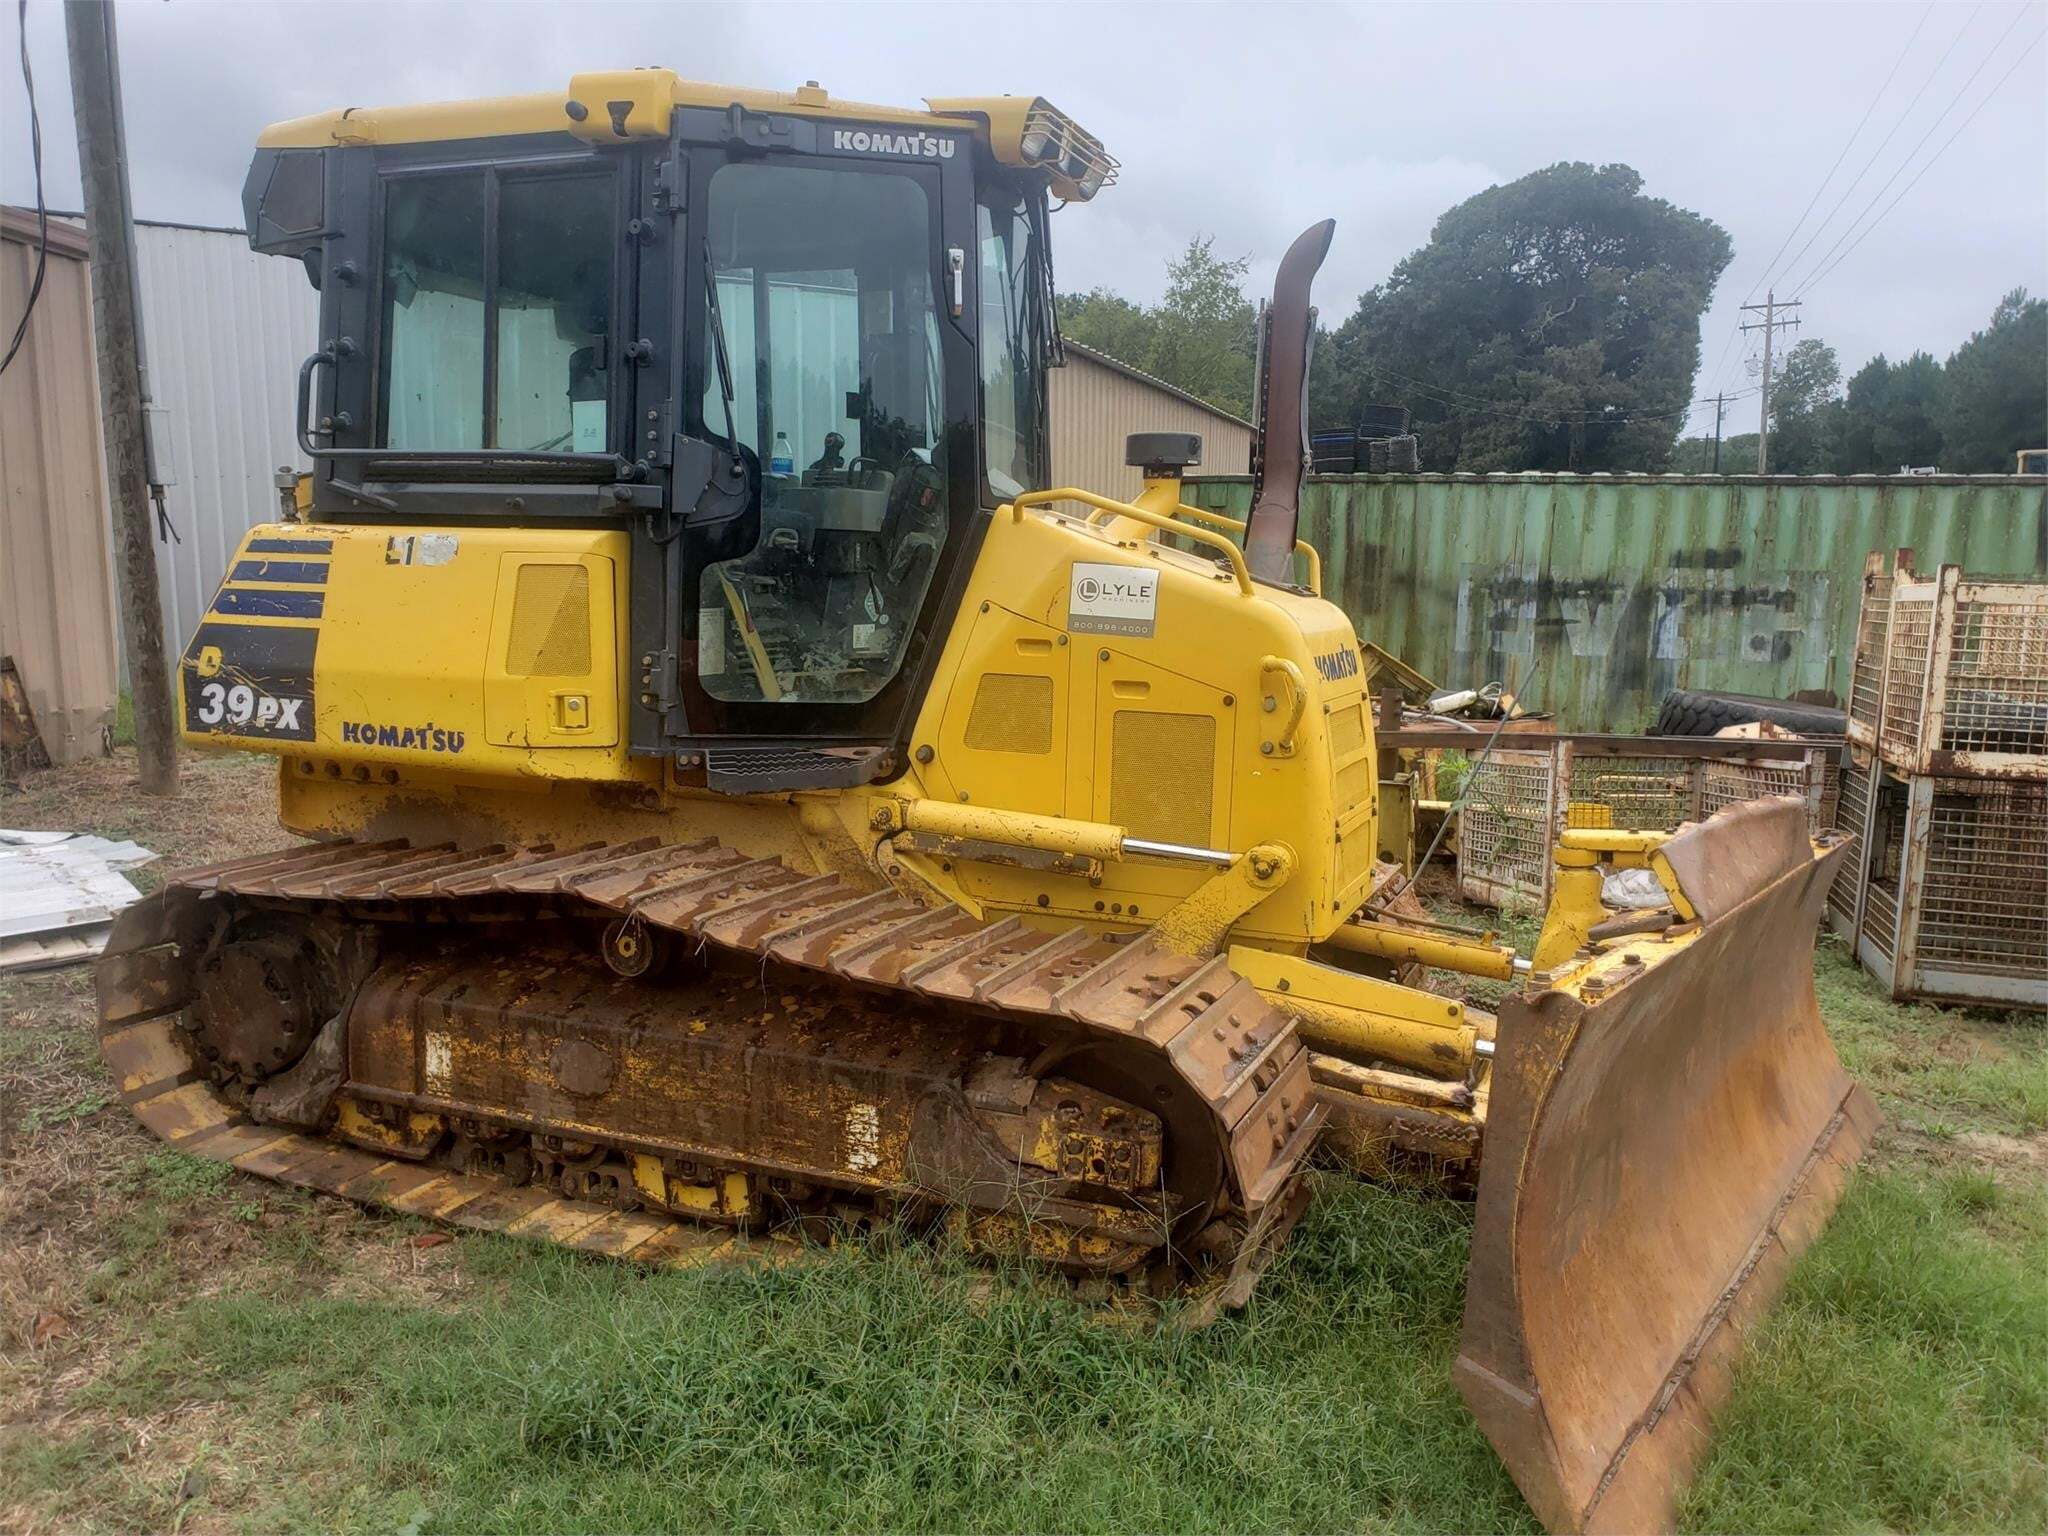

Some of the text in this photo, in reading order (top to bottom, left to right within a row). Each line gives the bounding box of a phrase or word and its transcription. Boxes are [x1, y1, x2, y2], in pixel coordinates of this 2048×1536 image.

[834, 131, 955, 158] KOMATSU
[1102, 583, 1151, 597] LYLE
[198, 683, 303, 730] 39PX
[343, 721, 464, 754] KOMATSU
